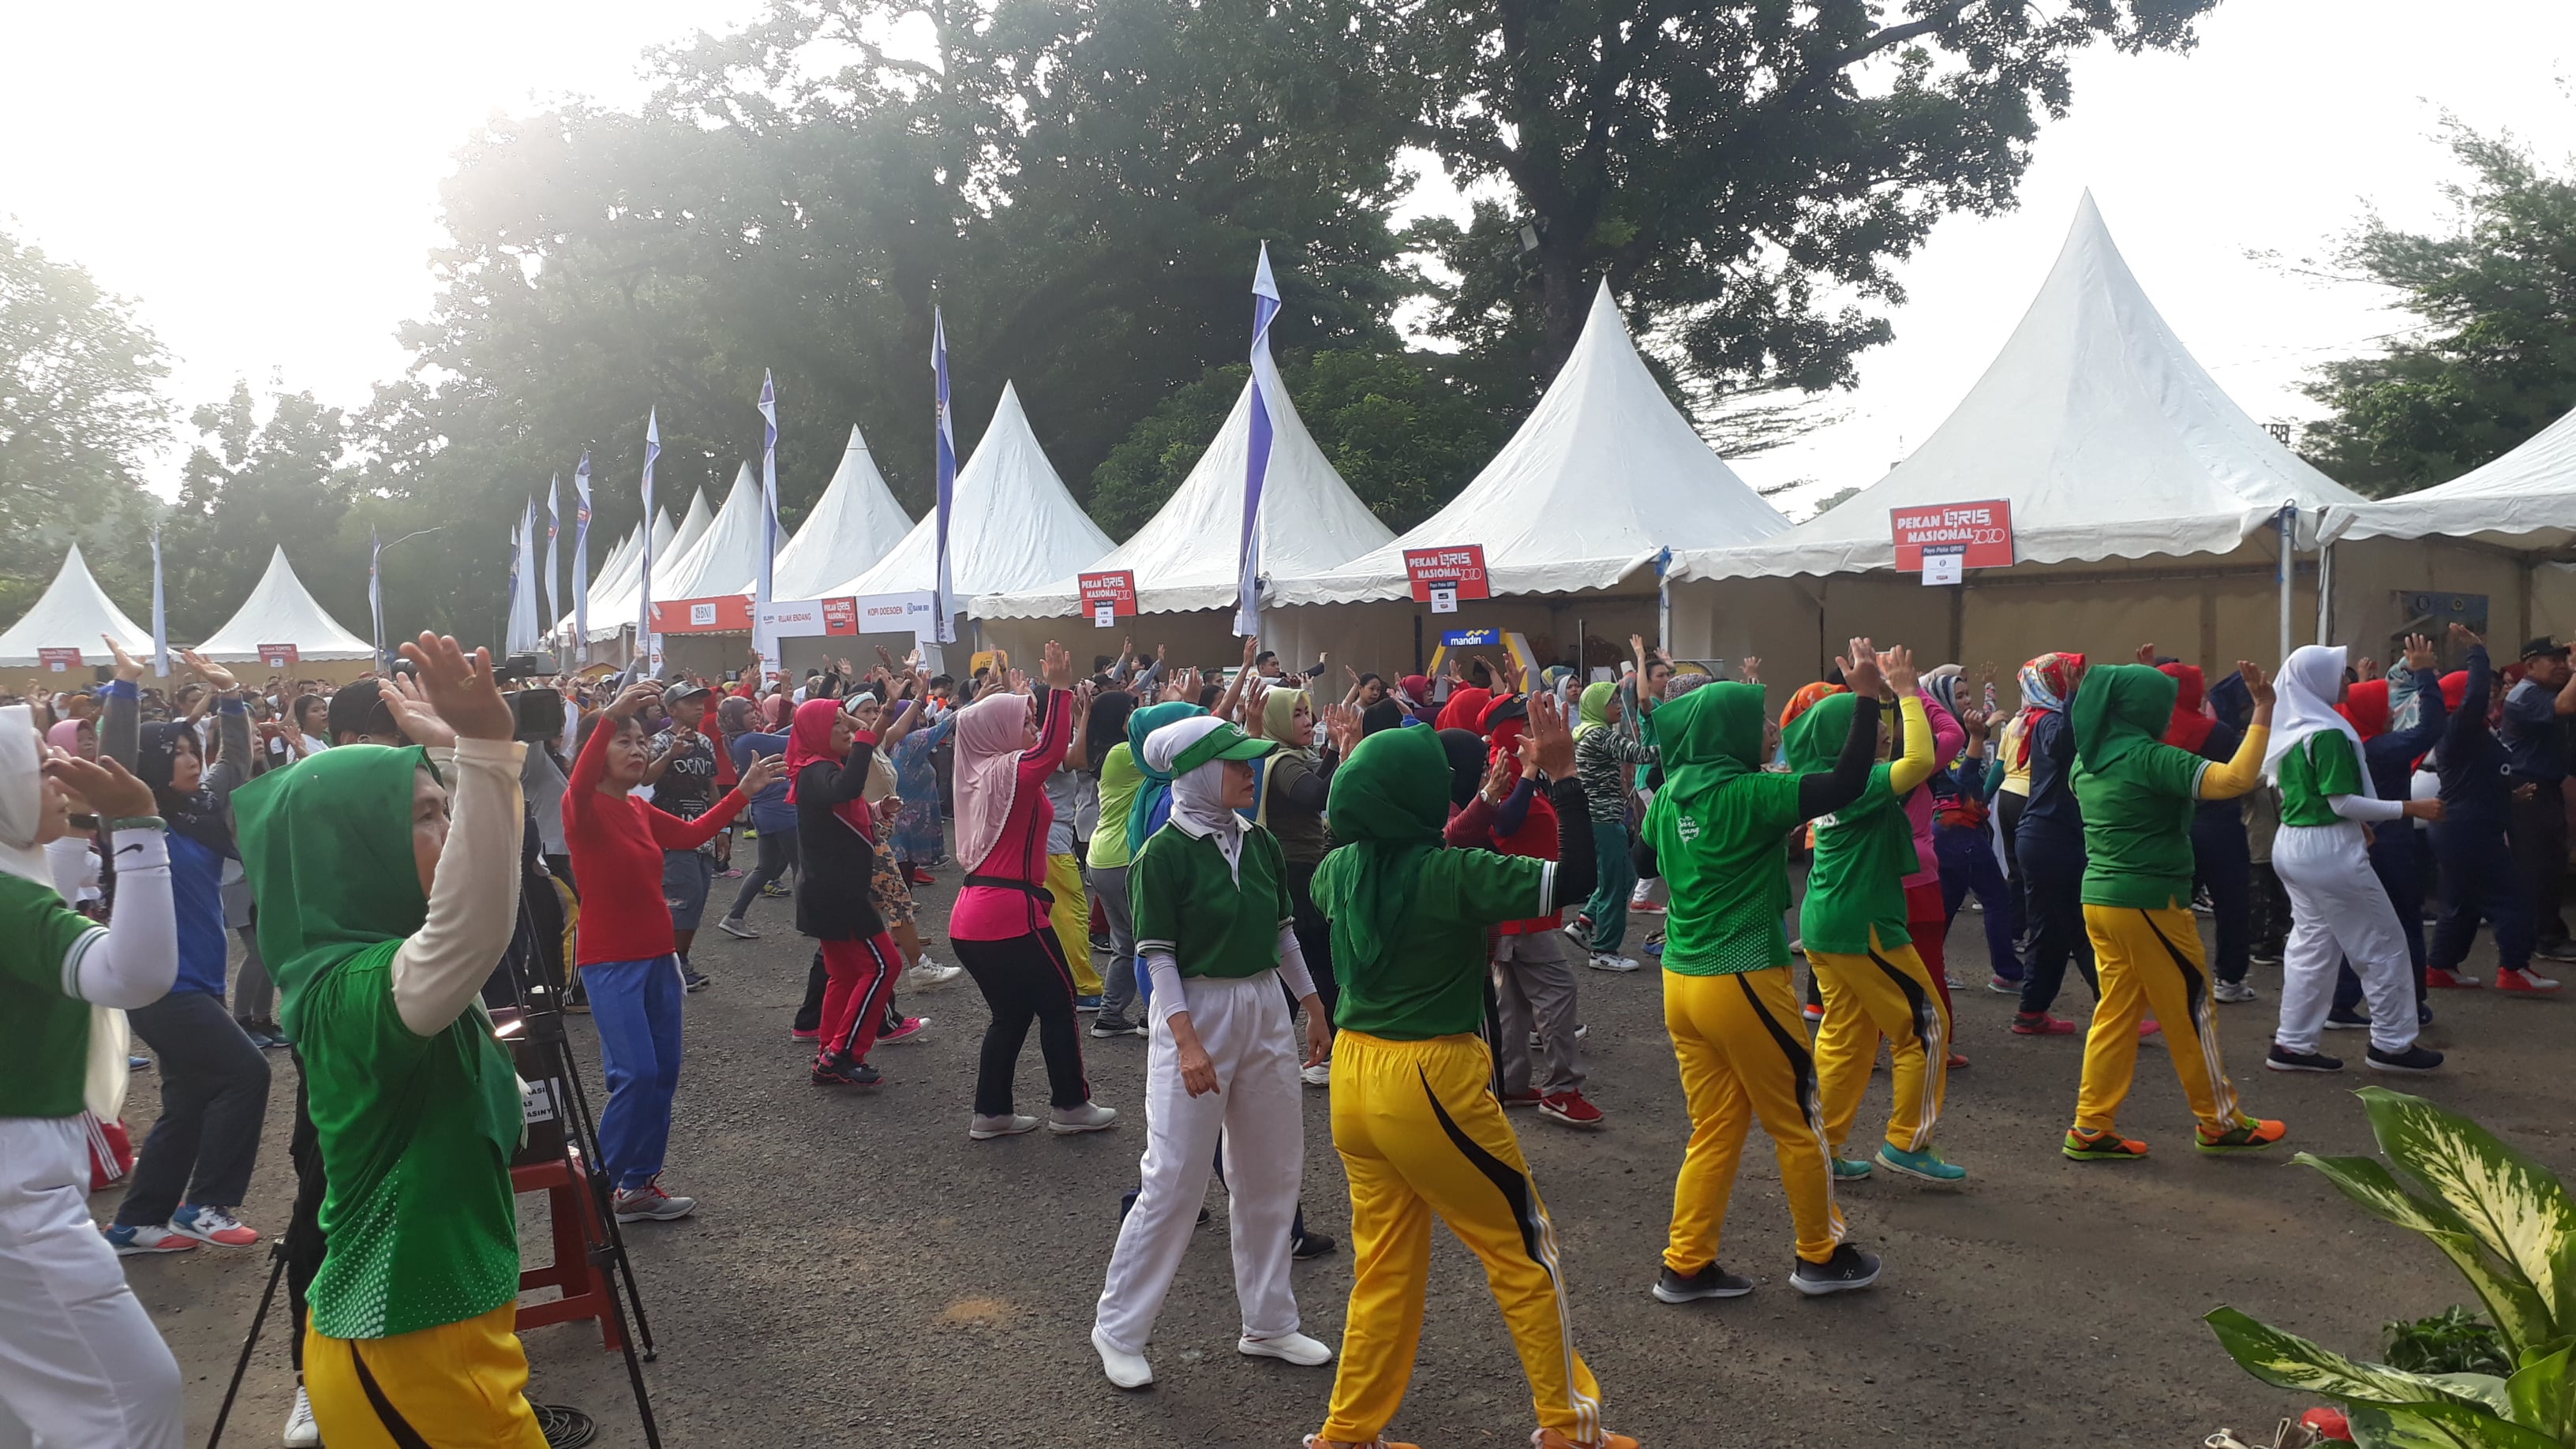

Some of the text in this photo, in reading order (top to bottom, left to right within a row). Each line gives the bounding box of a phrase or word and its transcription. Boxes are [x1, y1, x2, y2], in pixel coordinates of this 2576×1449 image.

[1897, 508, 1992, 530] PEKAN QRIS
[1908, 528, 2005, 544] NASIONAL 2020
[1409, 552, 1471, 567] PEKAN QRIS
[1417, 567, 1462, 578] NASIONAL
[1081, 579, 1102, 589] PEKAN
[1087, 589, 1118, 598] NASIONAL
[879, 606, 903, 615] DOESOEN
[792, 612, 811, 621] ENDANG
[1451, 635, 1481, 646] mandiri
